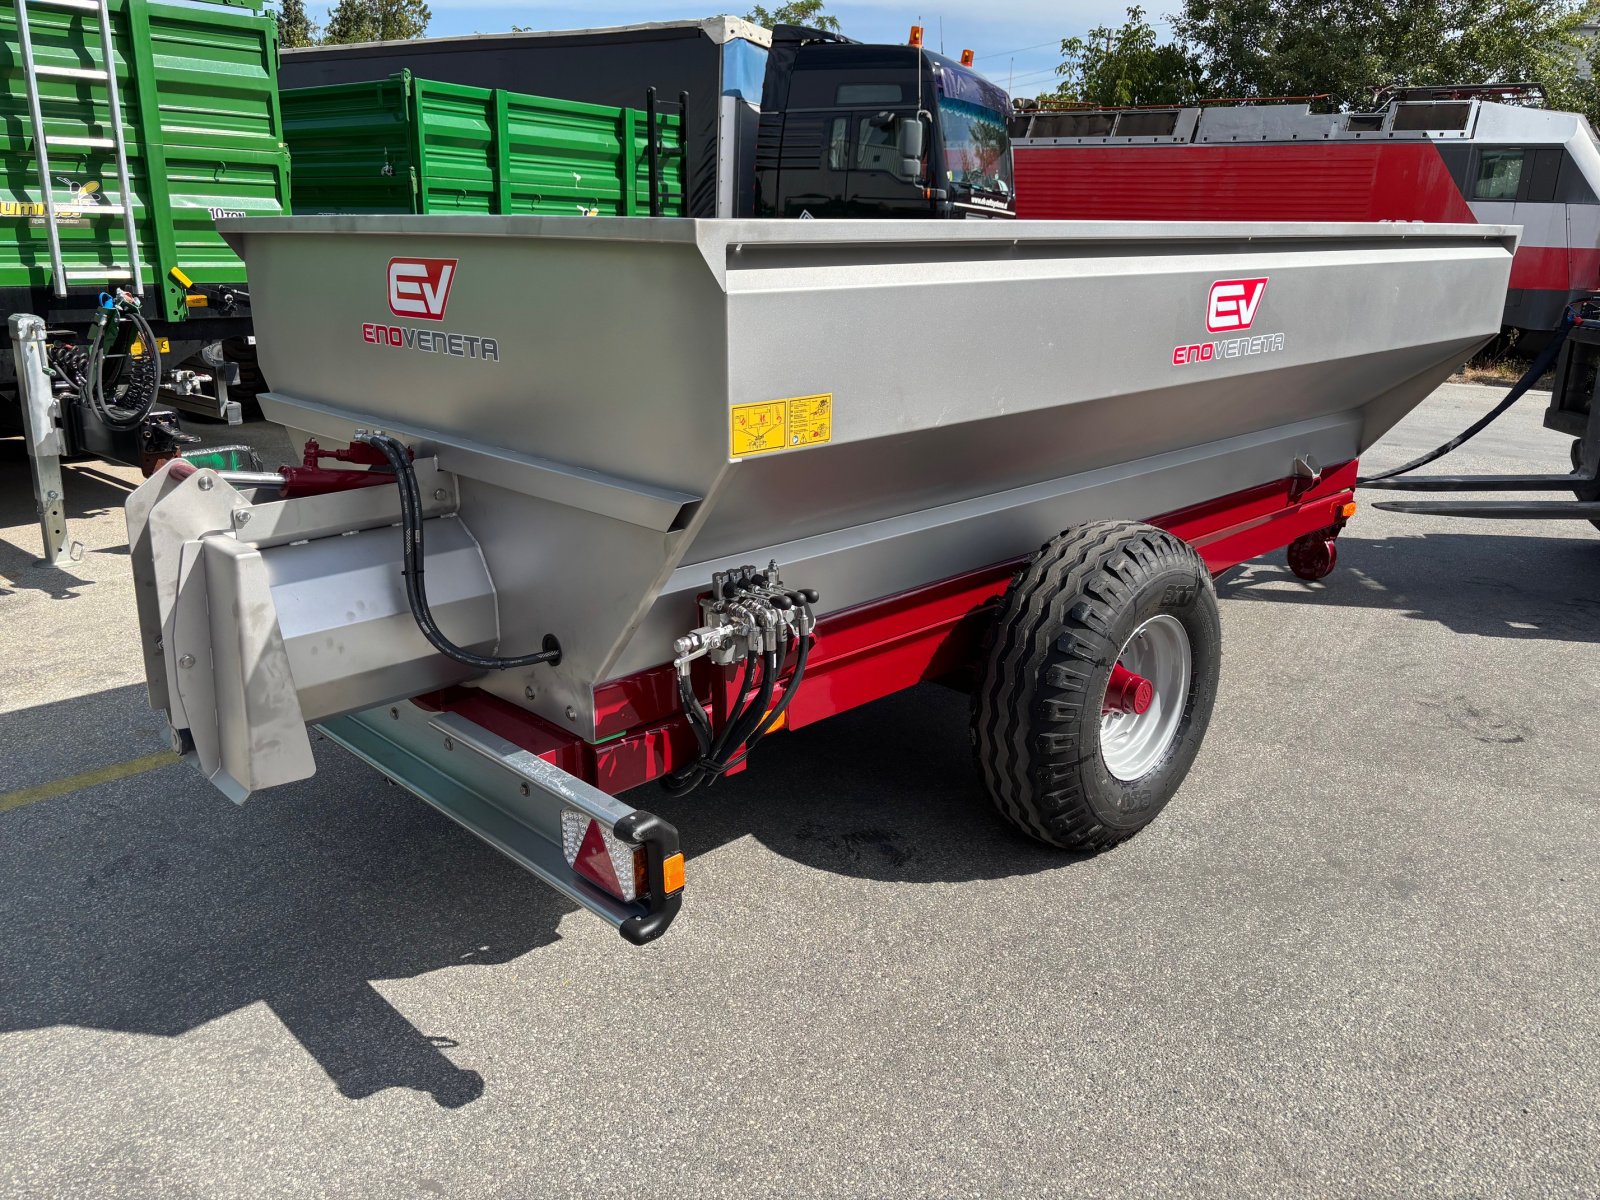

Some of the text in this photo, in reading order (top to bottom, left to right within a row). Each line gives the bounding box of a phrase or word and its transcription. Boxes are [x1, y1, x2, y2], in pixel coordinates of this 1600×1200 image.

[390, 262, 453, 315] EV
[1208, 282, 1265, 329] EV
[362, 322, 500, 362] ENOVENETA
[1173, 333, 1284, 365] ENOVENETA
